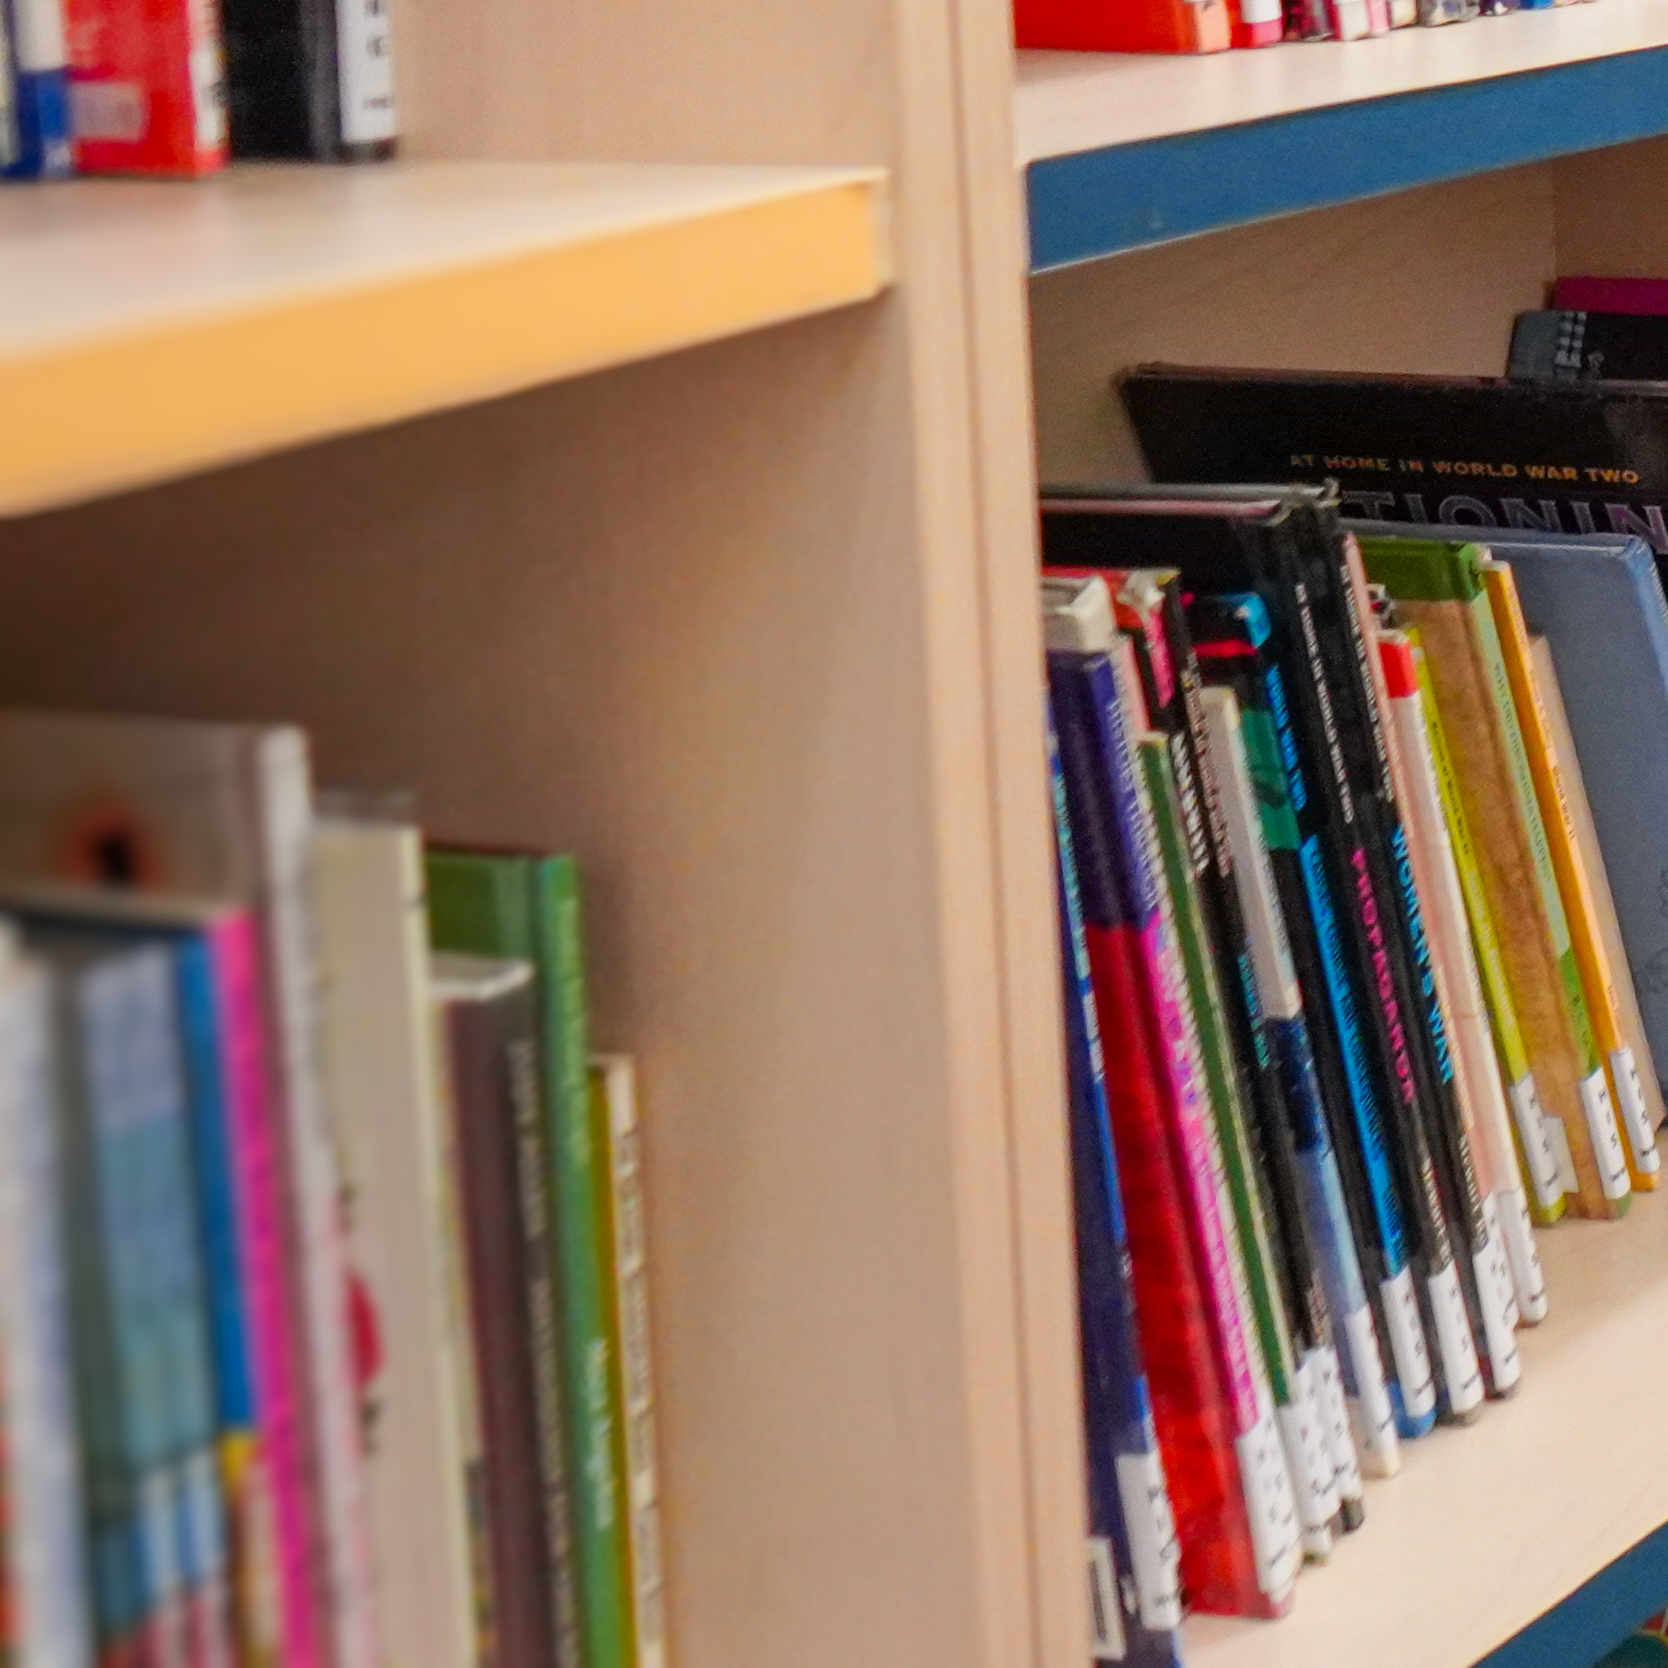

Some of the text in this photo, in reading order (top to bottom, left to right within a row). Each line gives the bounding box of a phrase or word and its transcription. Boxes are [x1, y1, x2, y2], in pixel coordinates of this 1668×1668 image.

[1289, 454, 1640, 487] AT HOME IN WORLD WAR TWO
[1329, 737, 1348, 788] WAR
[1389, 819, 1456, 1090] WOMEN'S WAR
